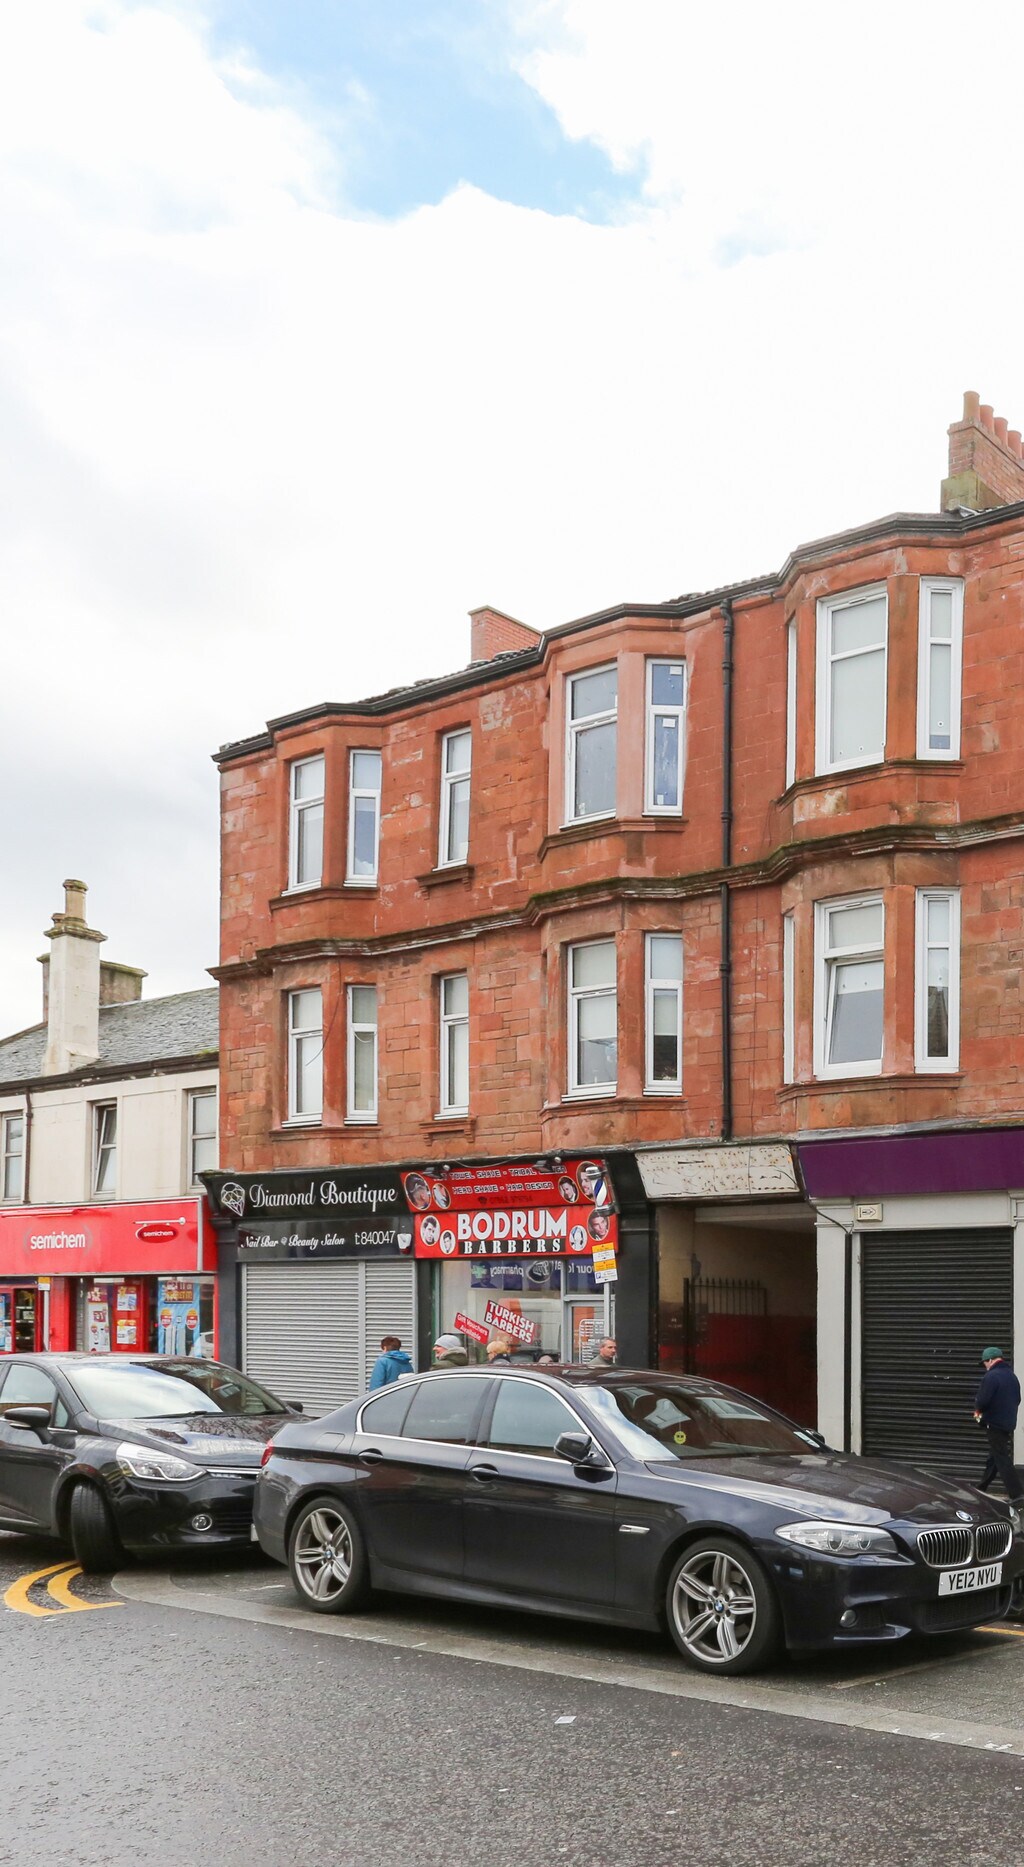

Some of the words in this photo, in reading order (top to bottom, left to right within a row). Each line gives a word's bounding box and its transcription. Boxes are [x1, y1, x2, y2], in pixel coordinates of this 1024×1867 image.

[450, 1171, 475, 1180] TOWEL
[477, 1169, 501, 1178] SHAVE
[509, 1167, 536, 1176] TRIBAL
[249, 1182, 316, 1208] Diamond
[320, 1180, 398, 1213] Boutique
[452, 1186, 472, 1195] HEAD
[474, 1185, 498, 1194] SHAVE
[506, 1183, 524, 1191] HAIR
[525, 1181, 554, 1190] DESIGN
[143, 1230, 174, 1238] semichem
[457, 1209, 567, 1240] BODRUM
[30, 1231, 86, 1250] semichem
[241, 1235, 261, 1248] Nail
[261, 1235, 279, 1247] Bar
[288, 1234, 319, 1250] Beauty
[321, 1233, 345, 1246] Salon
[464, 1238, 561, 1254] BARBERS
[489, 1301, 535, 1333] TURKISH
[485, 1312, 532, 1343] BARBERS
[948, 1571, 975, 1591] YE12
[977, 1566, 997, 1586] NYU
